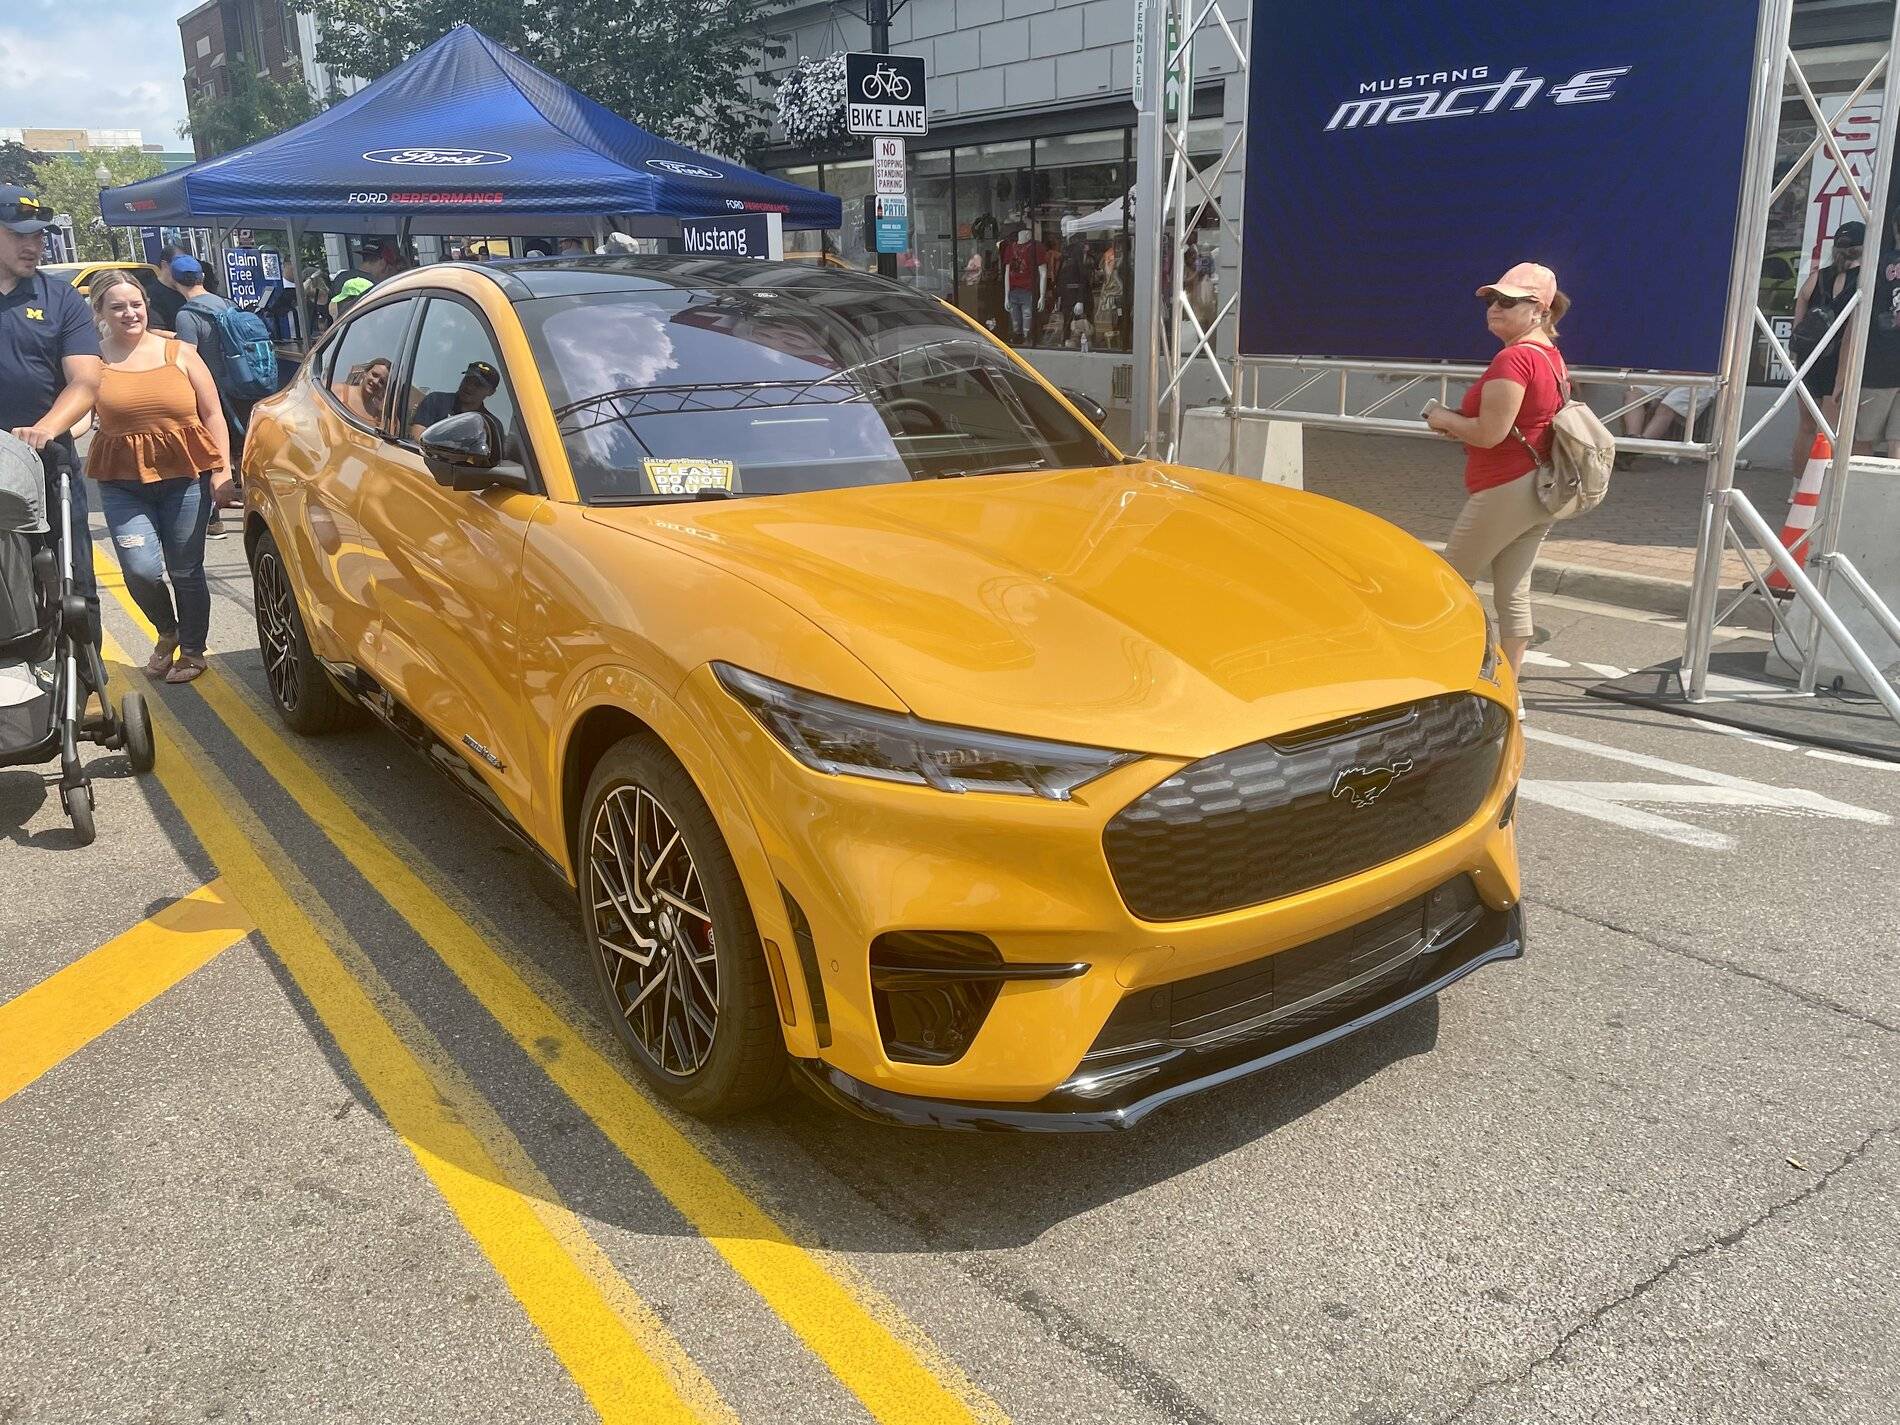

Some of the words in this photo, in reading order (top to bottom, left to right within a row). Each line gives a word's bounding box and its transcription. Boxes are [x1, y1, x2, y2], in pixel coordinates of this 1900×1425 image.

[1360, 66, 1488, 93] MUSTANG
[852, 109, 883, 126] BIKE
[889, 110, 923, 128] LANE
[883, 143, 896, 156] NO
[390, 151, 485, 164] Ford
[877, 159, 903, 168] STOPPING
[660, 161, 713, 177] Ford
[877, 169, 903, 178] STANDING
[879, 180, 902, 188] PARKING
[348, 193, 388, 204] FORD
[391, 193, 504, 204] PERFORMANCE
[726, 199, 744, 210] FORD
[684, 227, 747, 255] Mustang
[227, 252, 258, 267] Claim
[229, 268, 253, 281] Free
[231, 282, 256, 295] Ford
[655, 467, 725, 476] PLEASE
[656, 476, 682, 485] DO
[688, 476, 726, 485] NOT
